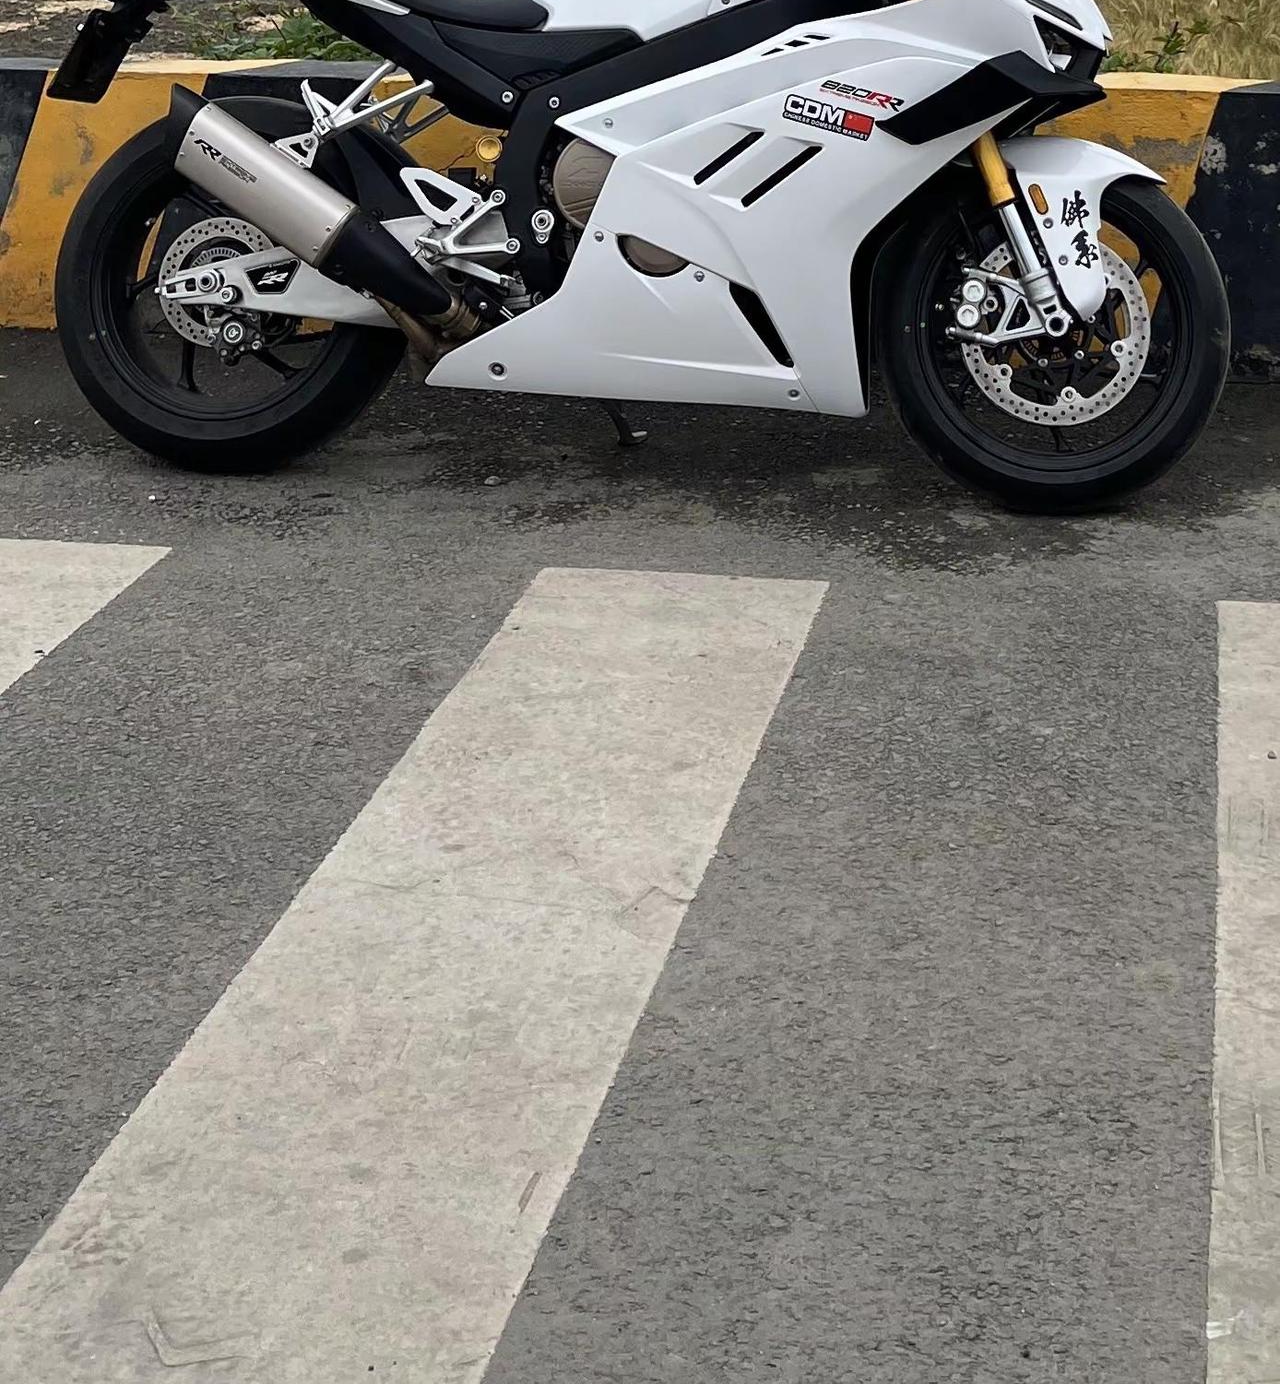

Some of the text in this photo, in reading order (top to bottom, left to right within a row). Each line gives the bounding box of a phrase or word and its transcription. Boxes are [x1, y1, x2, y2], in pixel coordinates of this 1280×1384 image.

[784, 95, 845, 126] CDM
[811, 119, 842, 133] DOMESTIC
[842, 127, 868, 140] MARKET
